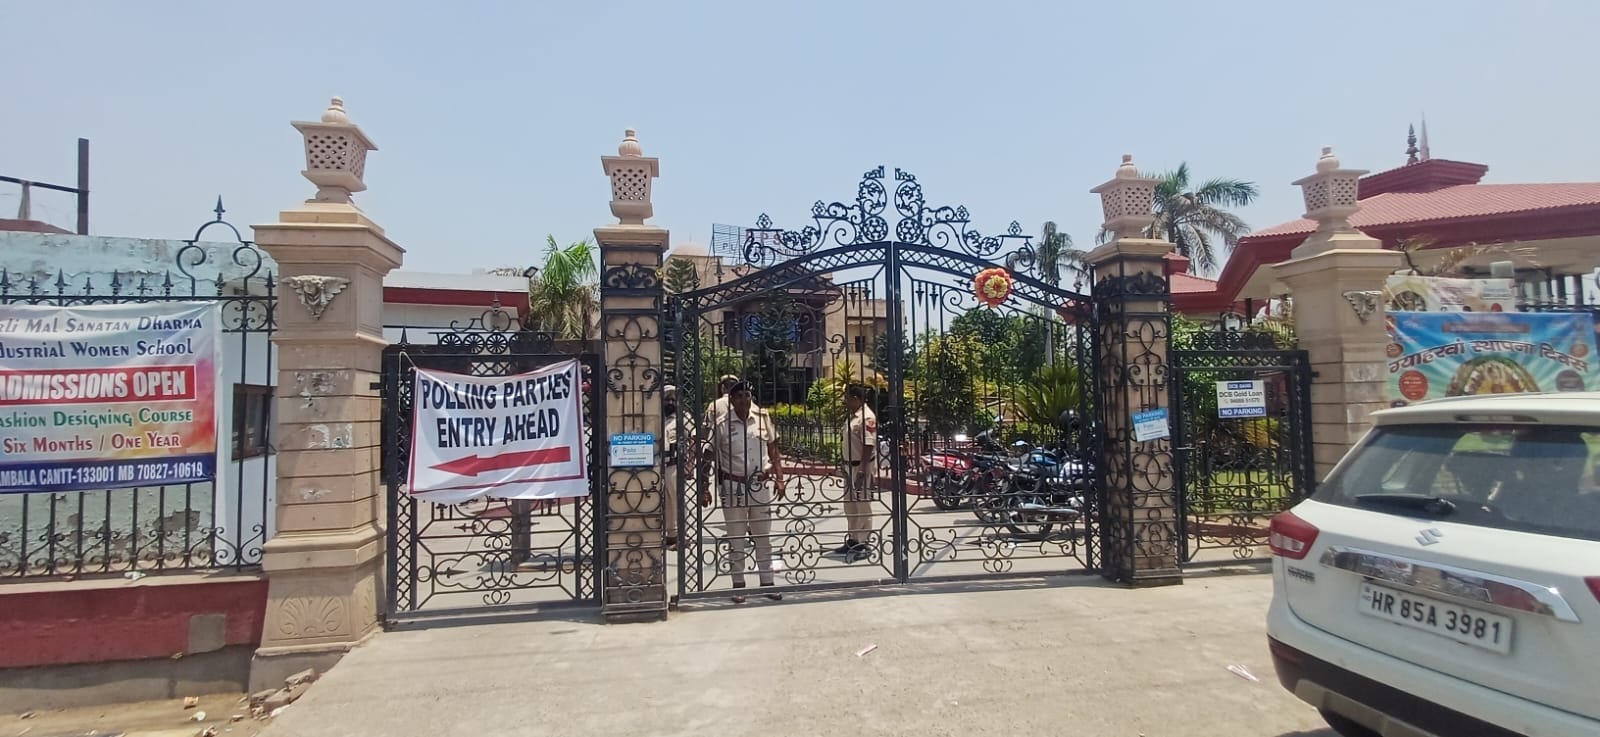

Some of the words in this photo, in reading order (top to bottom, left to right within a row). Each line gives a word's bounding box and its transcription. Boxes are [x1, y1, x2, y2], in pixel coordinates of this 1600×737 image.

[70, 341, 129, 357] WOMEN
[133, 370, 186, 397] OPEN
[421, 378, 497, 410] POLLING
[503, 371, 572, 408] PARTIES
[139, 407, 192, 424] COURSE
[1221, 408, 1233, 416] NO
[1233, 407, 1263, 415] PARKING
[111, 433, 141, 449] ONE
[147, 432, 181, 448] YEAR
[437, 416, 497, 448] ENTRY
[502, 407, 560, 445] AHEAD
[0, 469, 37, 487] MBALA
[40, 465, 115, 485] CANTT-133001
[118, 464, 135, 482] MB
[137, 461, 204, 481] 70827-10619
[1371, 590, 1394, 615] HR
[1400, 597, 1437, 627] 85A
[1445, 610, 1501, 644] 3981
